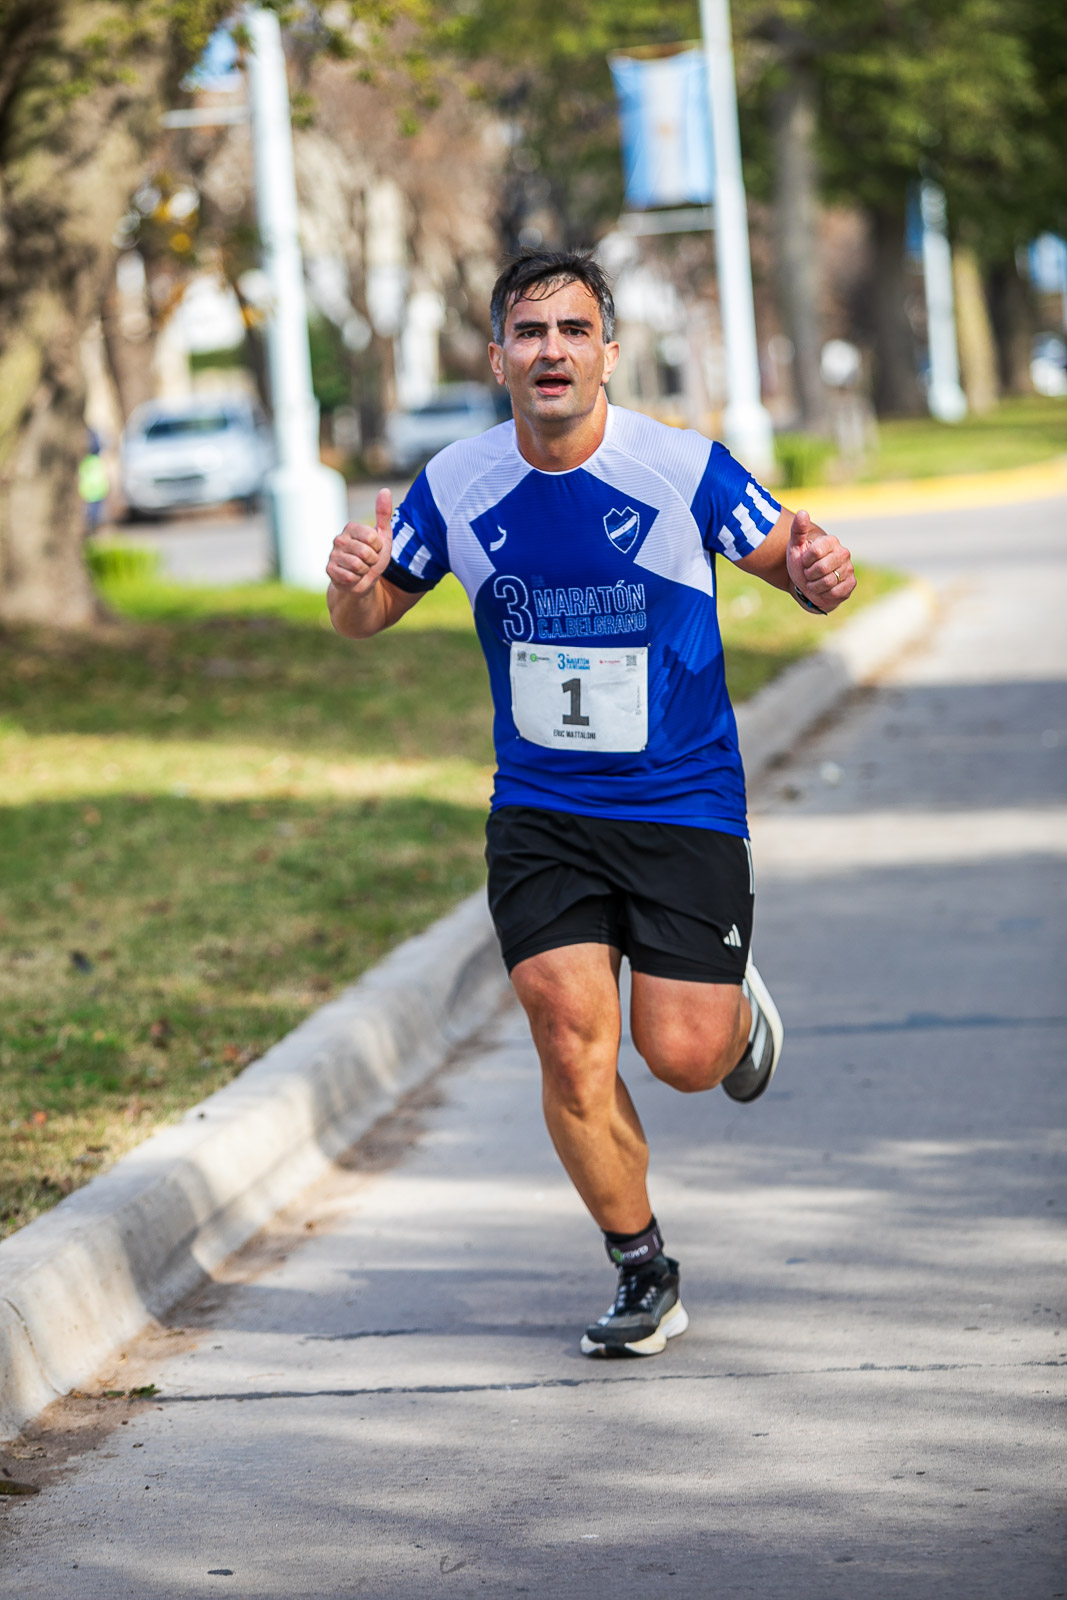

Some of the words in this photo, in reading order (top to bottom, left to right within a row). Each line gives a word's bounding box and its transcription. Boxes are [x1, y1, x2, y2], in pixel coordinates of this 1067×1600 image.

[493, 575, 535, 643] 3
[532, 580, 646, 618] MARATÓN
[557, 653, 566, 670] 3
[561, 677, 590, 726] 1
